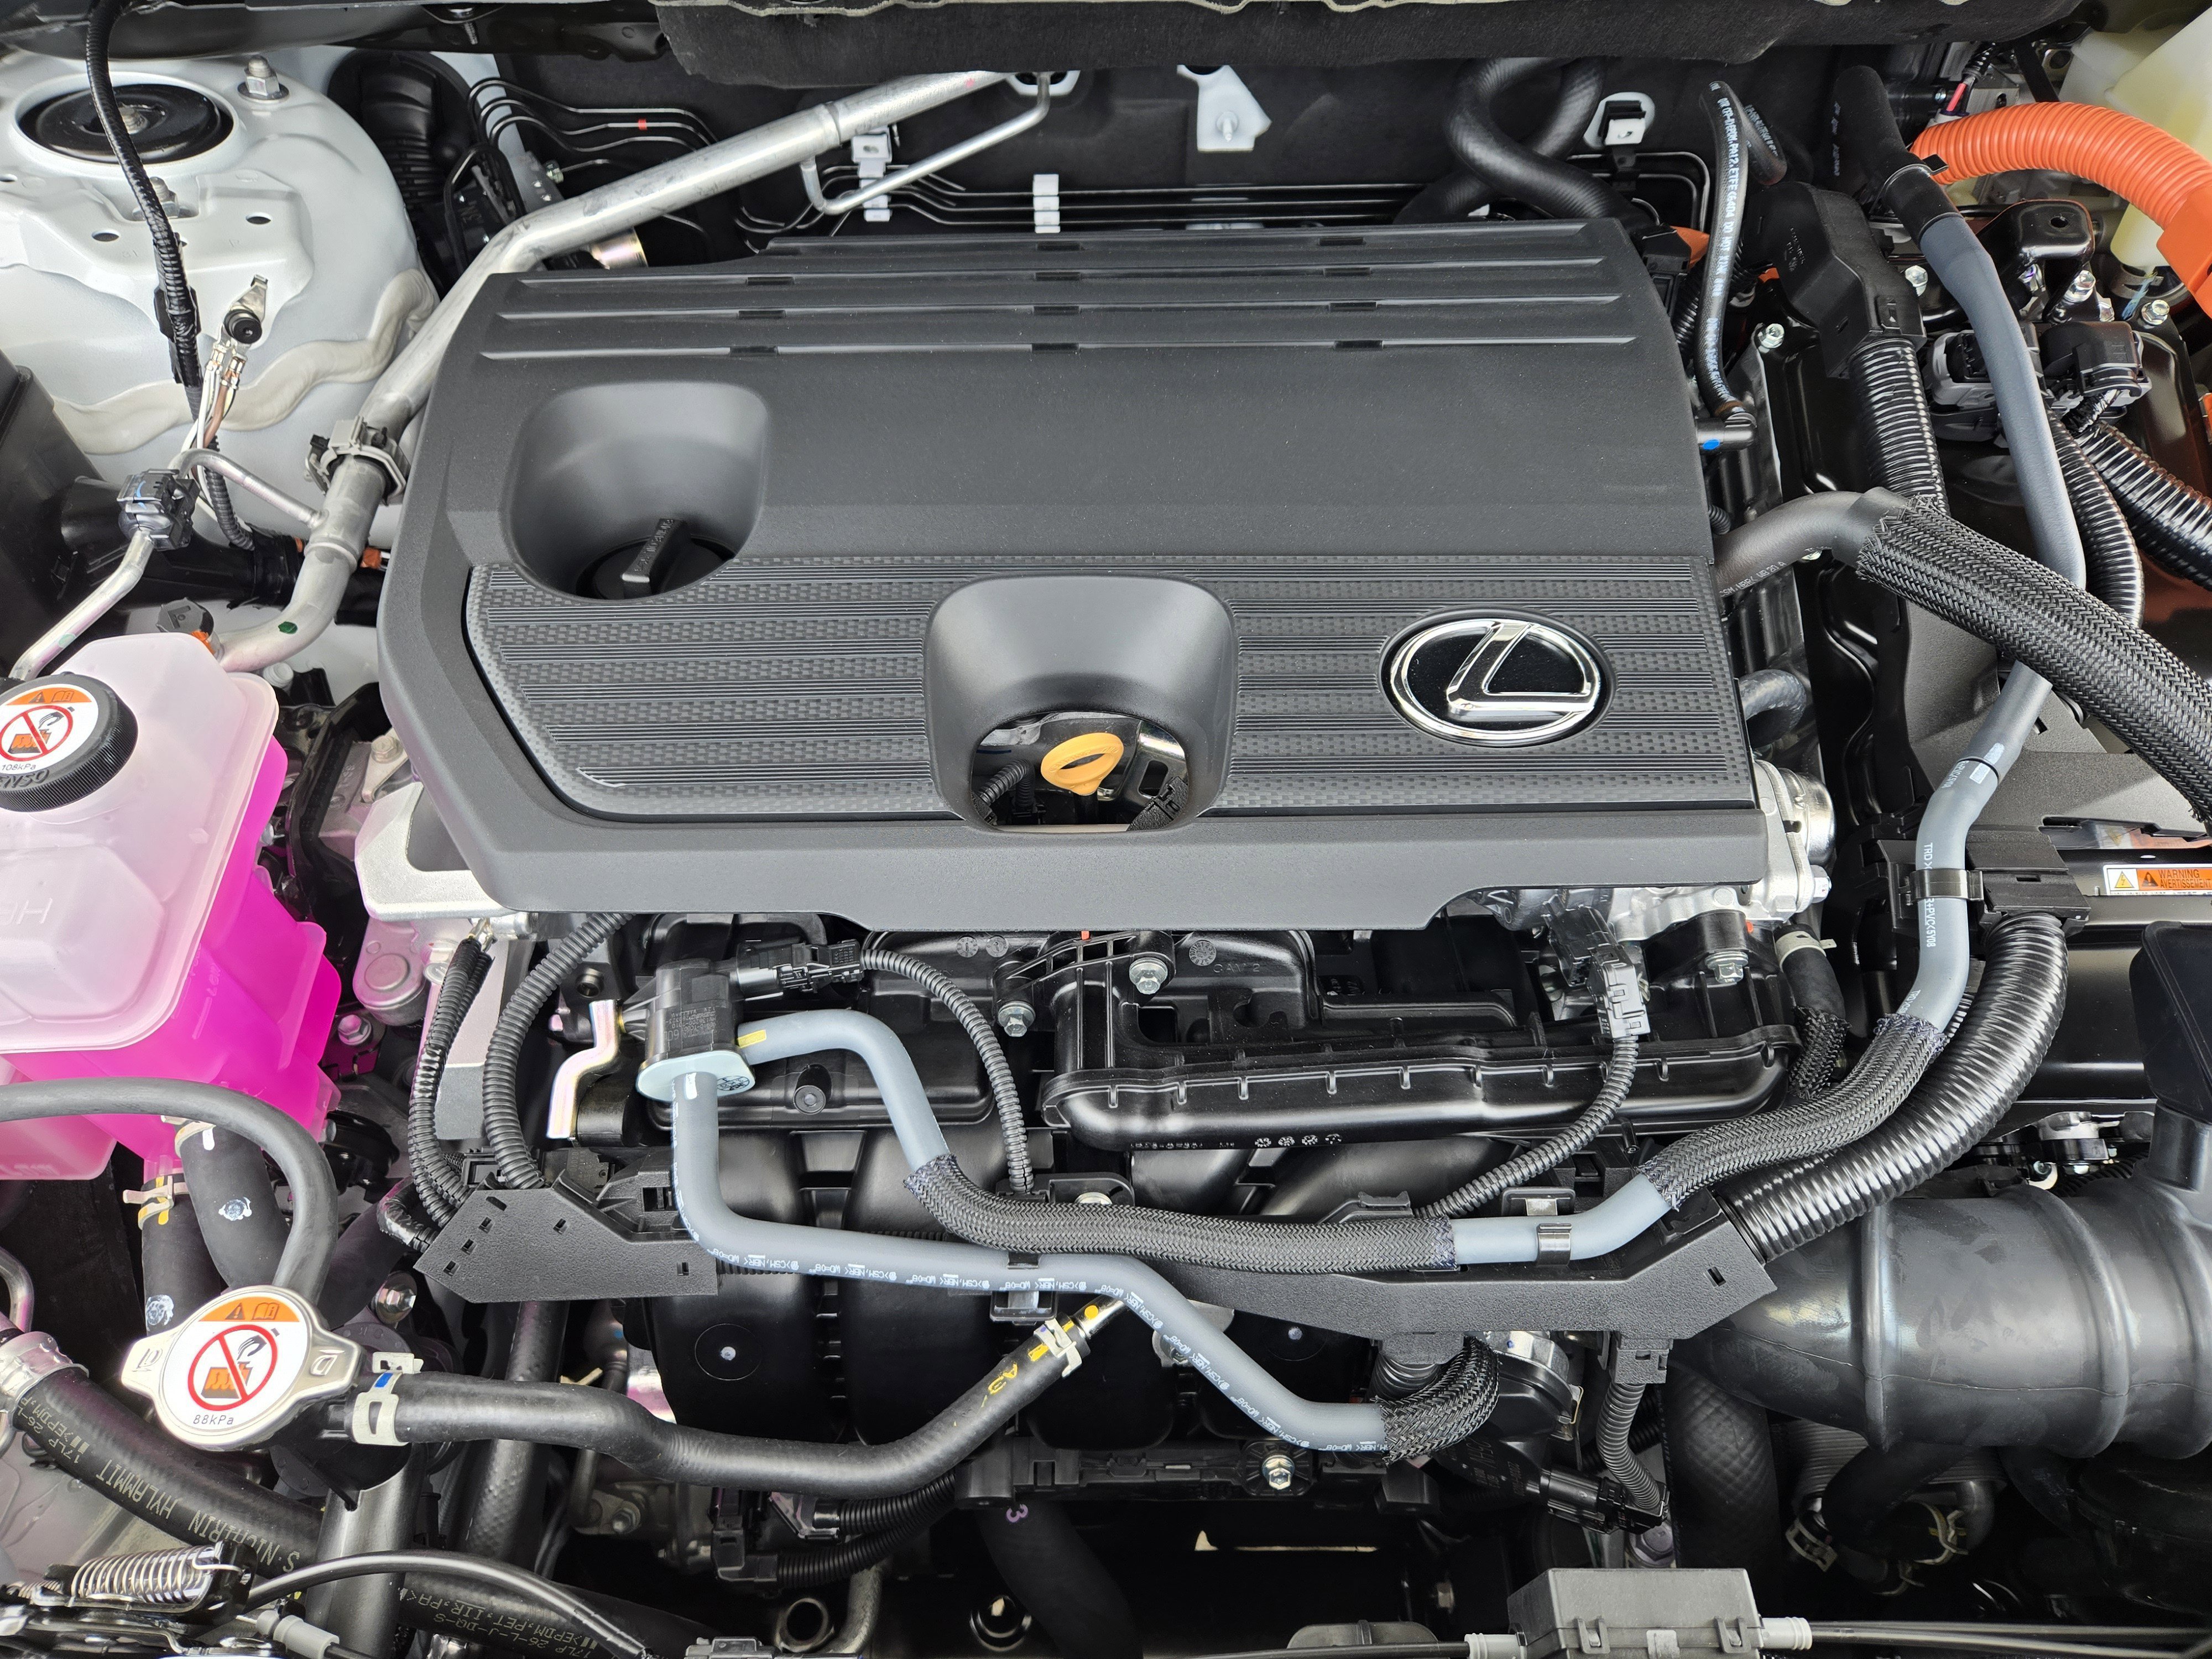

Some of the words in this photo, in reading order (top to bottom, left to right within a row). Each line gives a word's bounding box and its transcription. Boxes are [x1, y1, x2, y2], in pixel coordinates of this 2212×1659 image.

[2157, 869, 2200, 878] WARNING
[2160, 879, 2212, 888] AVERTISSEMENT
[193, 1413, 236, 1427] 88kPa
[95, 1458, 179, 1521] HYLAMMIT
